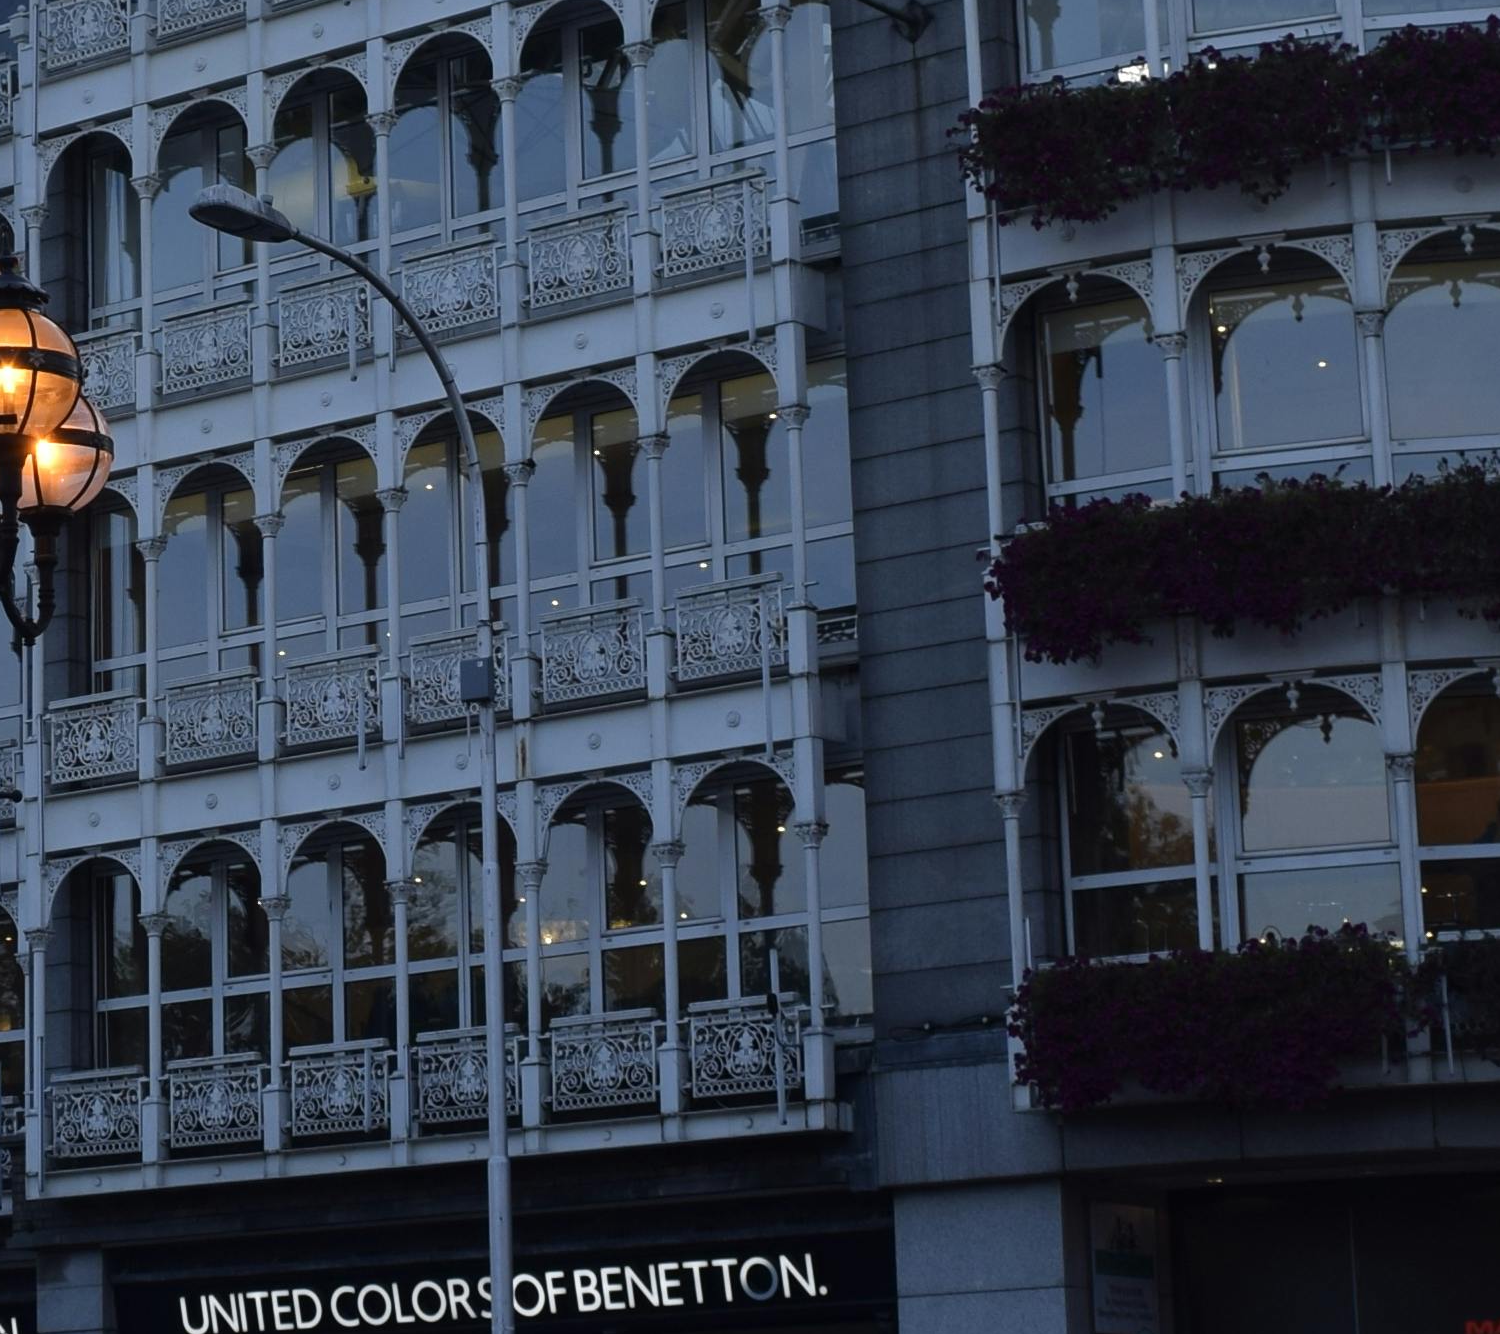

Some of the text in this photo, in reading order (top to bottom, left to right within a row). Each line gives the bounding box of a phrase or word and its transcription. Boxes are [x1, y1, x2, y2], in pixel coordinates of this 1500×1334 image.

[330, 1277, 493, 1328] COLORS
[512, 1270, 566, 1317] OF
[573, 1252, 829, 1313] BENETTON.
